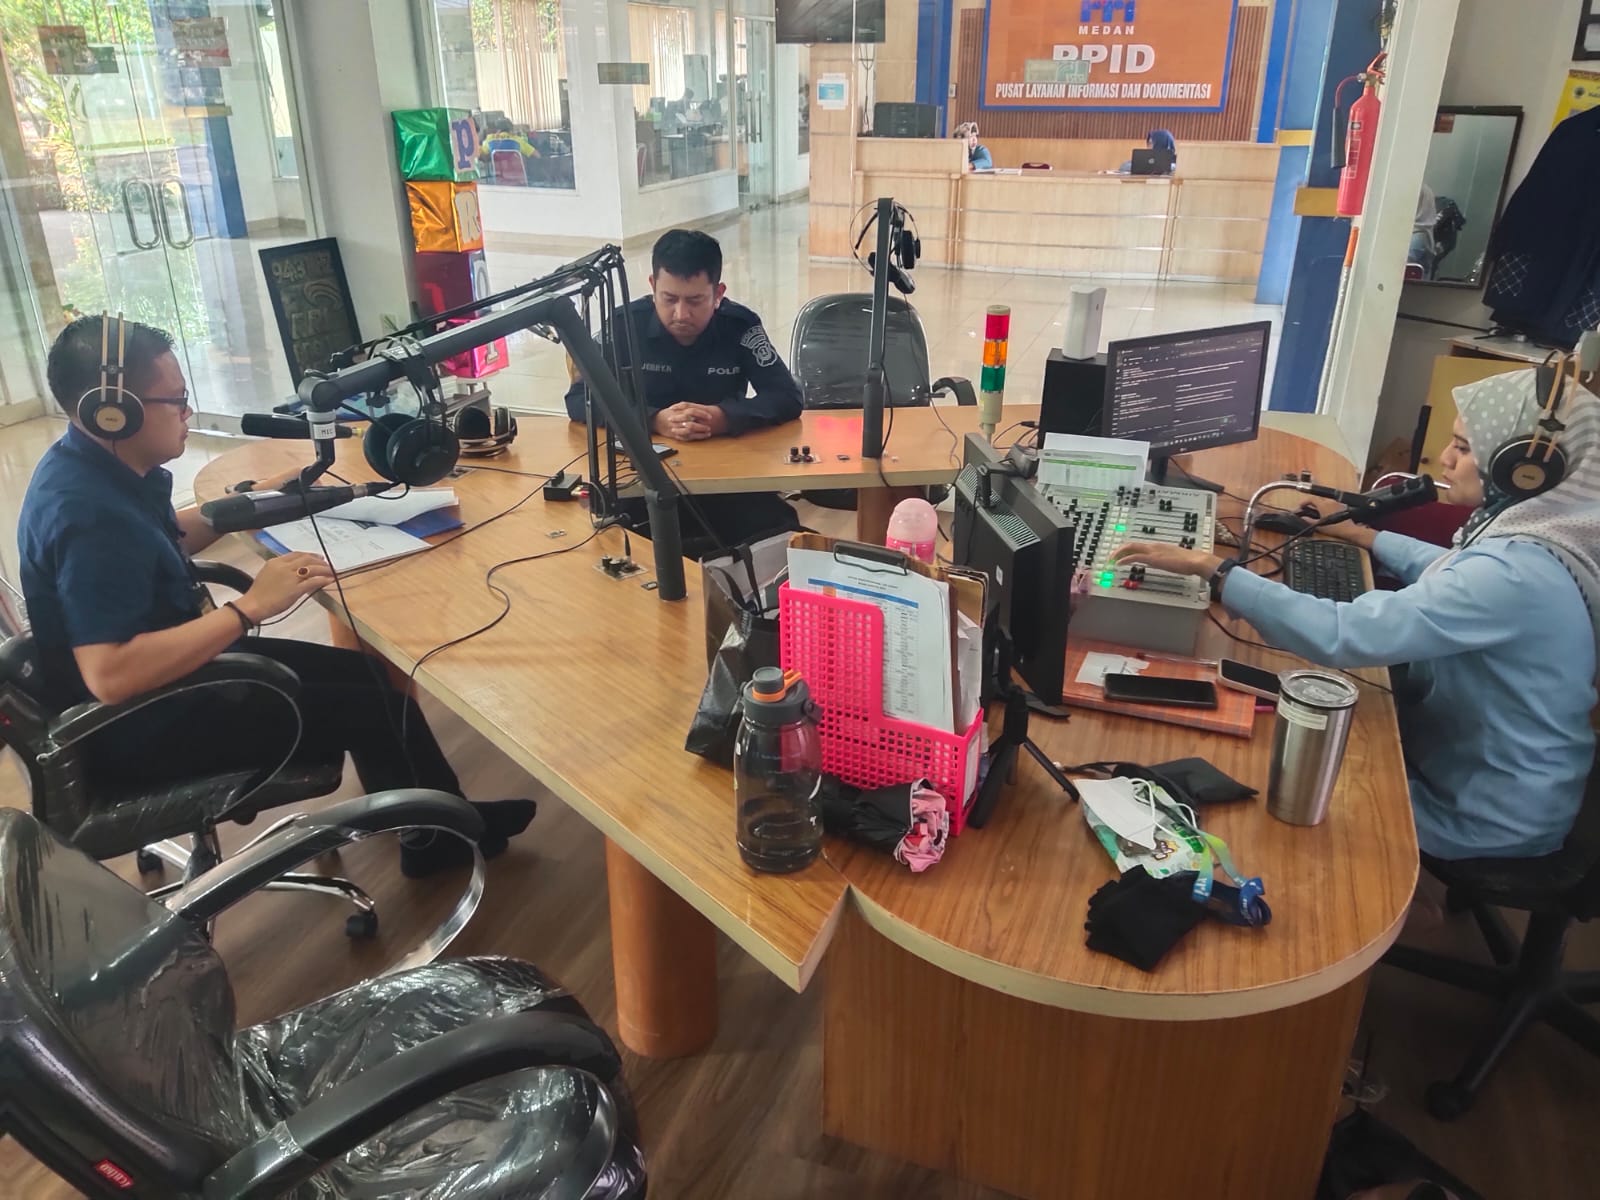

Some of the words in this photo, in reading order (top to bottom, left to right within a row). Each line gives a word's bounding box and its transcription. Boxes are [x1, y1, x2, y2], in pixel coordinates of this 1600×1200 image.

[1078, 25, 1135, 35] MEDAN
[1052, 44, 1156, 74] PPID
[995, 83, 1024, 98] PUSAT
[1025, 83, 1066, 98] LAYANAN
[1067, 83, 1120, 98] INFORMASI
[1121, 83, 1142, 98] DAN
[1142, 83, 1212, 99] DOKUMENTASI
